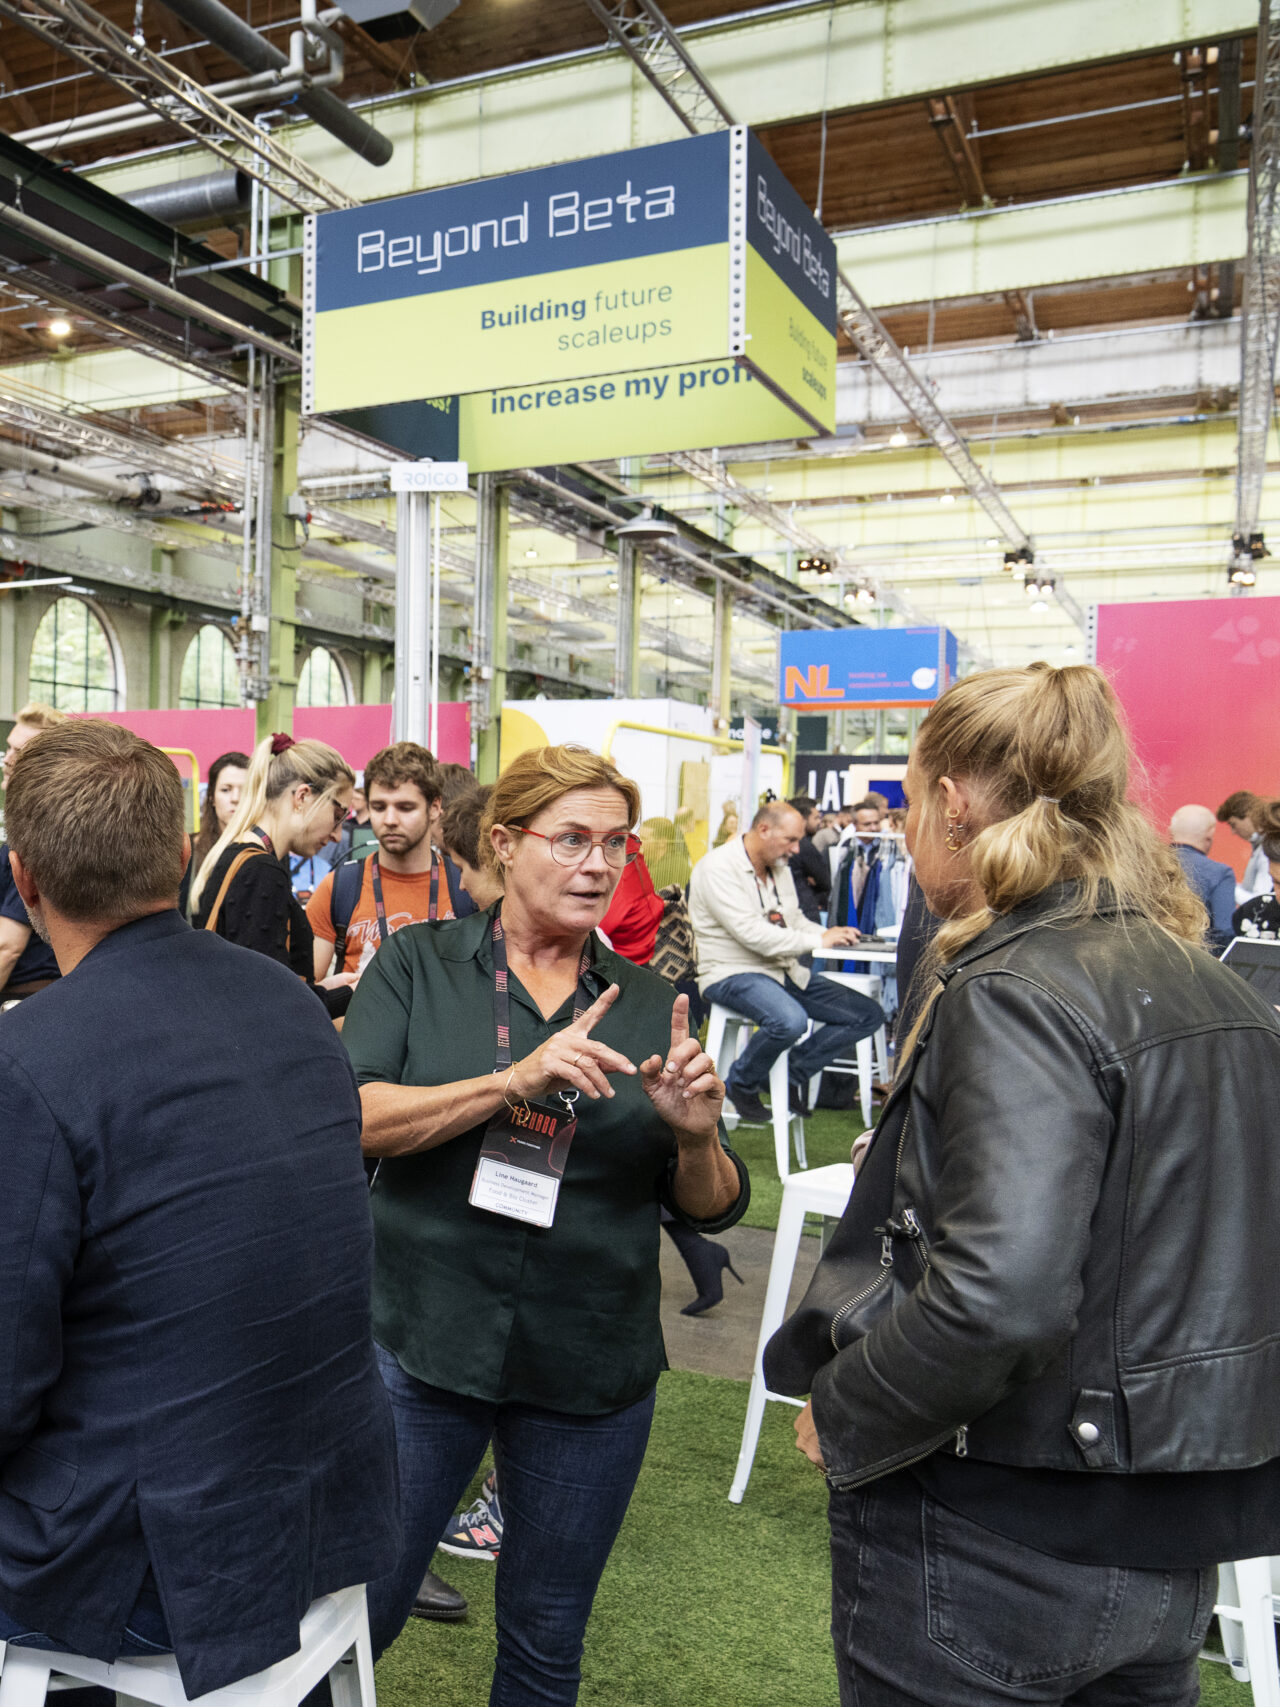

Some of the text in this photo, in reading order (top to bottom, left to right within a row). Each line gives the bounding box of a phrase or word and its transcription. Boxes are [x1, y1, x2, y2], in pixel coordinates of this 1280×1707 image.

[357, 179, 675, 275] Beyond Beta
[756, 174, 830, 299] Beyond Beta
[480, 285, 673, 331] Building future
[557, 318, 673, 352] scaleups
[490, 381, 616, 415] increase
[624, 374, 670, 400] my
[402, 472, 459, 486] ROICO
[784, 664, 846, 699] NL
[469, 1523, 499, 1547] N
